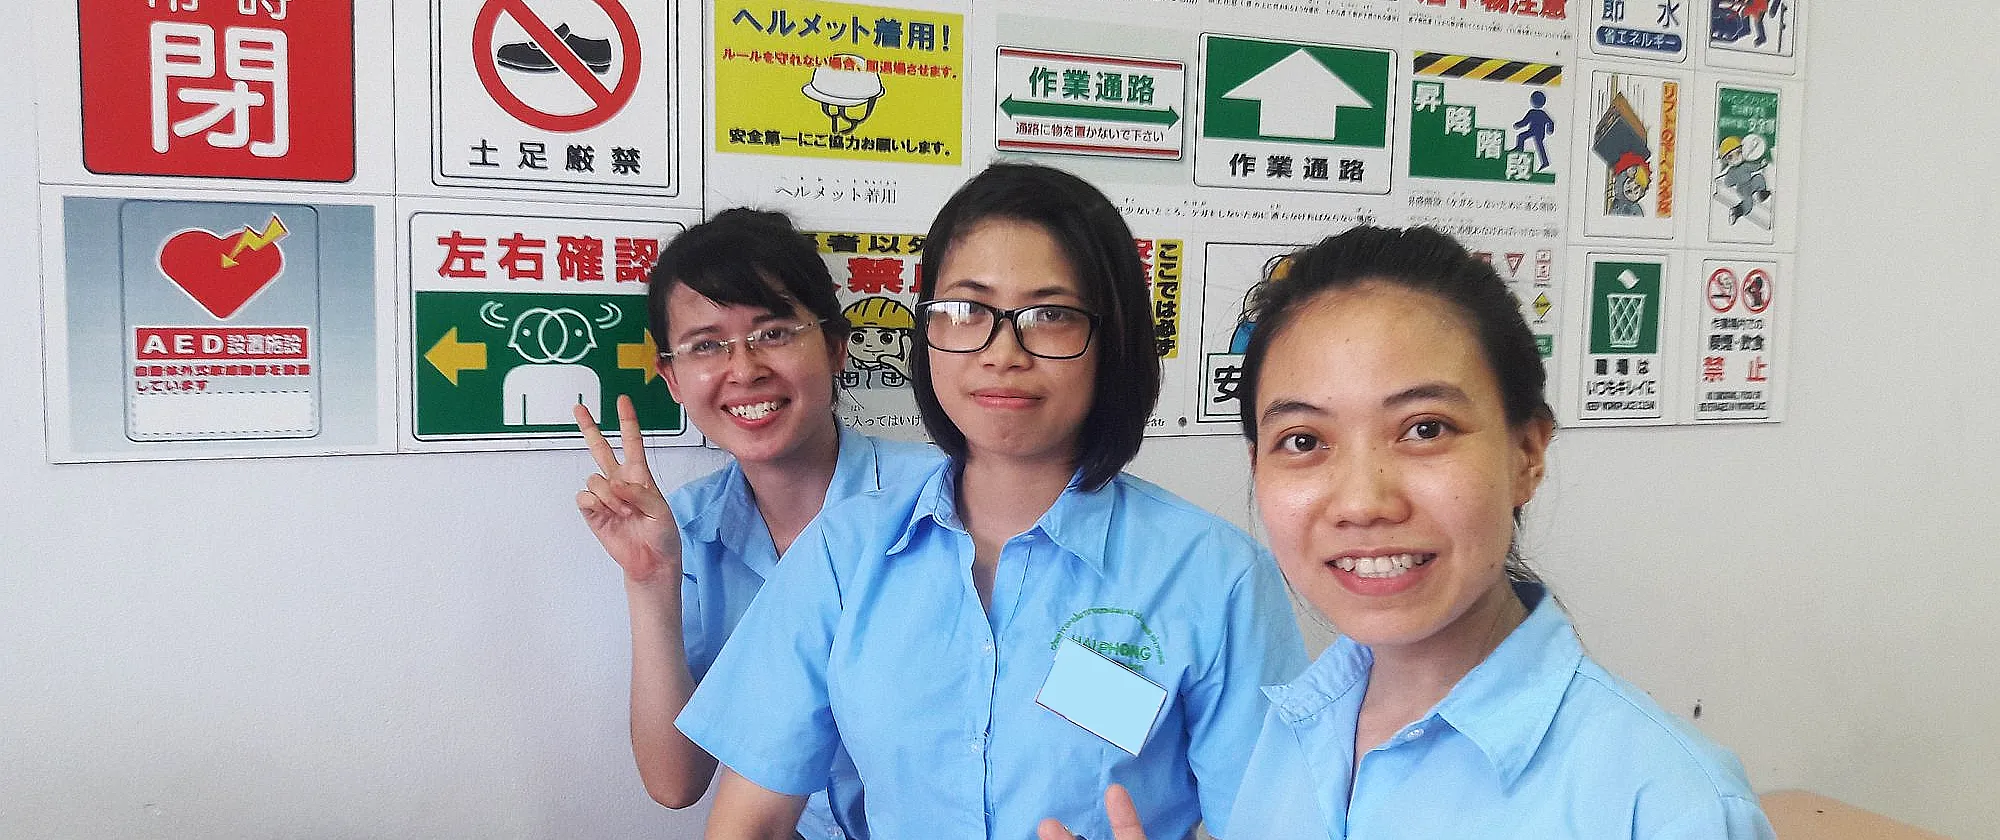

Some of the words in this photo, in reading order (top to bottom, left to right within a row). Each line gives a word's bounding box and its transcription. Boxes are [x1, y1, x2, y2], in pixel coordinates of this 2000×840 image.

[149, 20, 290, 158] 閉
[1028, 66, 1155, 105] 作業通路
[469, 139, 641, 175] 土足厳禁
[1229, 153, 1365, 183] 作業通路
[437, 231, 658, 283] 左右確認
